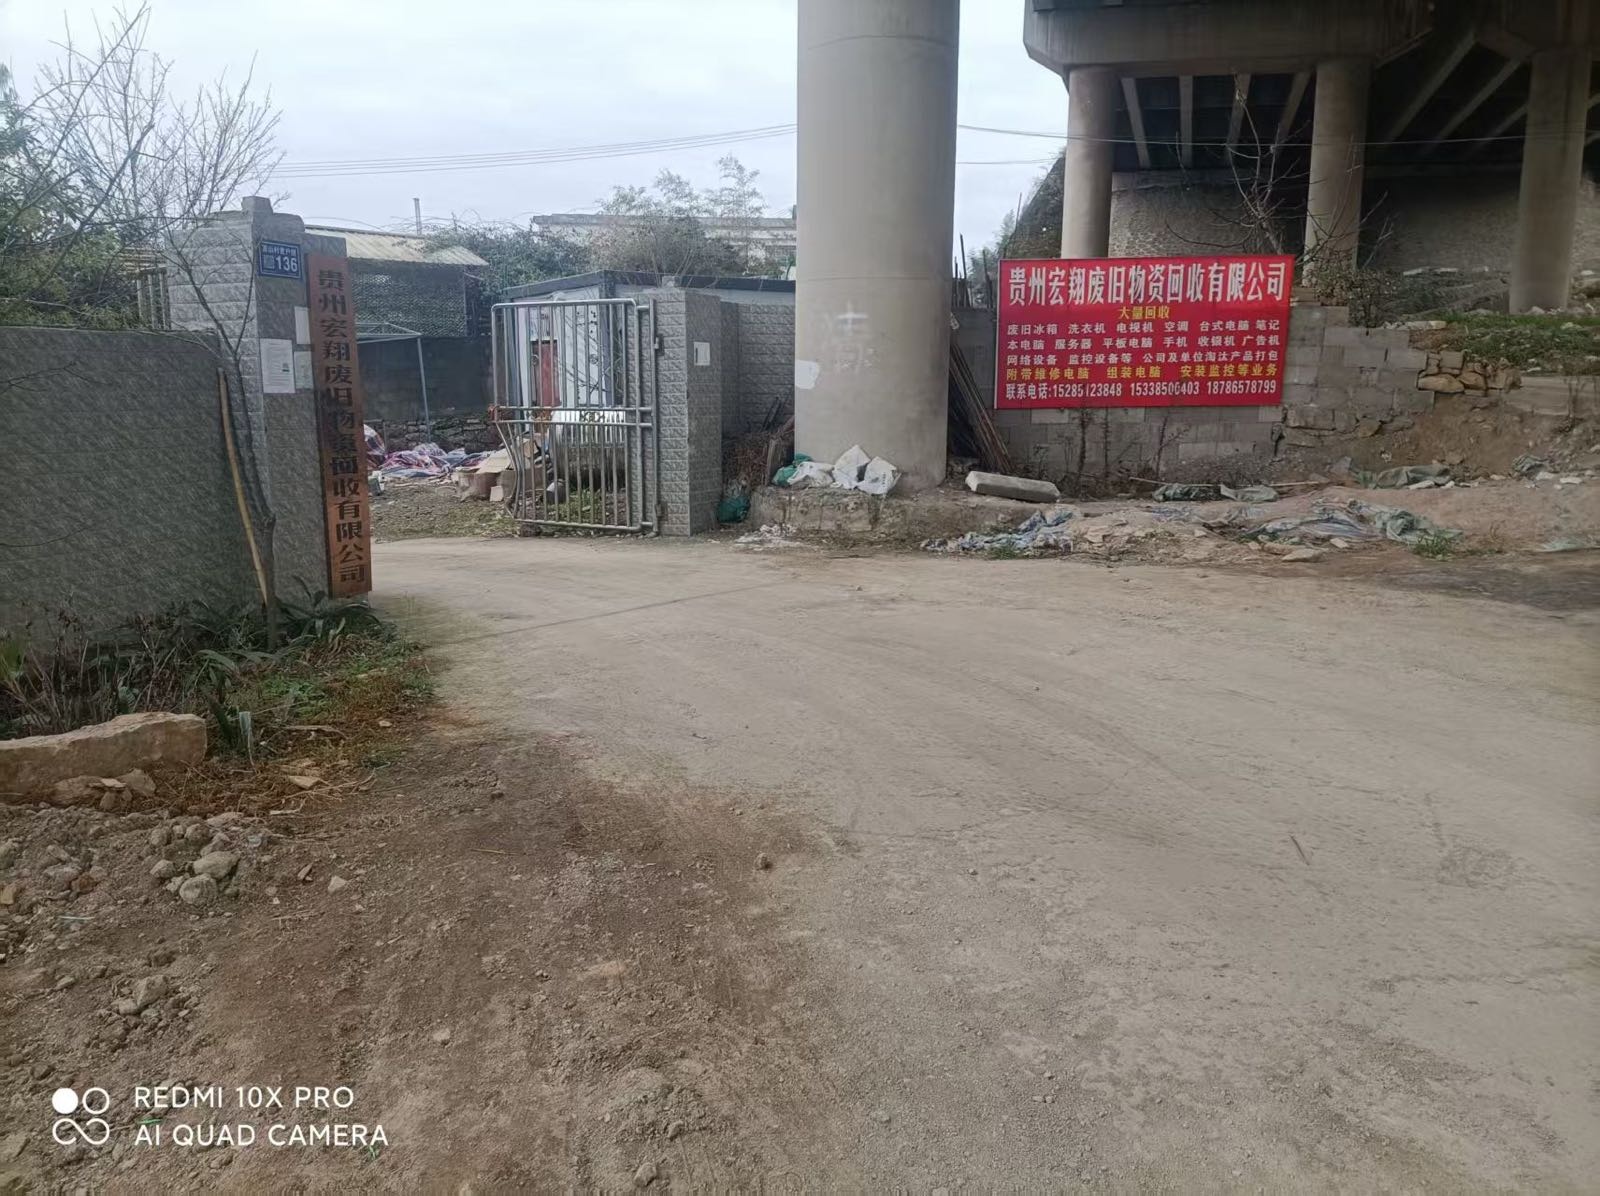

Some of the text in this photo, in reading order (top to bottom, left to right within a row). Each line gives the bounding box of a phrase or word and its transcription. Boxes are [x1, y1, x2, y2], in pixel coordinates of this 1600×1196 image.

[275, 256, 298, 272] 136
[1008, 261, 1286, 307] 贵州宏翔废旧物资回收有限公司
[1118, 306, 1171, 319] 大量回收
[1006, 319, 1280, 335] 废旧冰箱 洗衣机 电视机 空调 台式电脑 笔记
[1006, 334, 1280, 350] 本电脑 服务器 平板电脑 手机 收银机 广告机
[1006, 350, 1279, 366] 网络设备 监控设备等 公司及单位淘汰产品打包
[1006, 363, 1278, 381] 附带维修电脑 组装电脑 安装监控等业务
[1206, 380, 1277, 395] 18786578799
